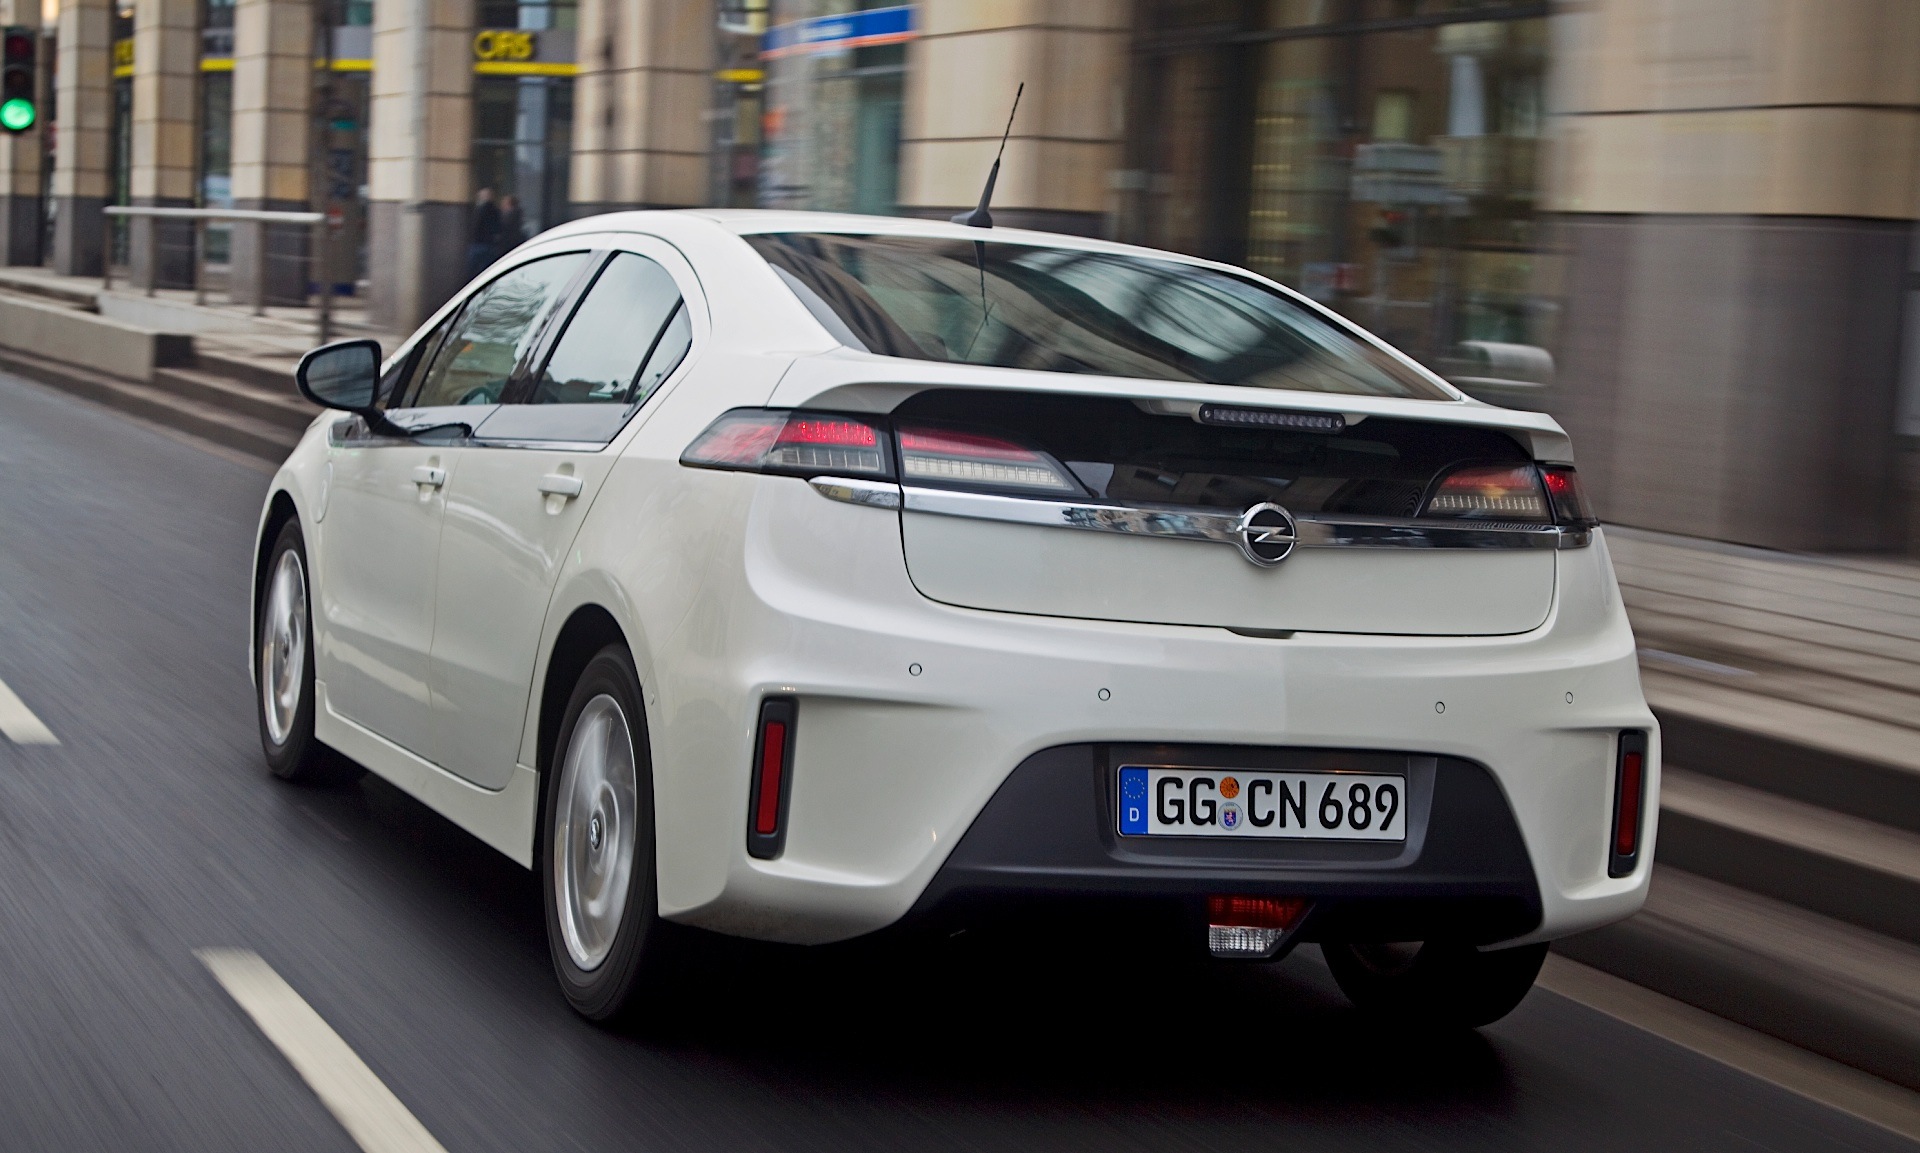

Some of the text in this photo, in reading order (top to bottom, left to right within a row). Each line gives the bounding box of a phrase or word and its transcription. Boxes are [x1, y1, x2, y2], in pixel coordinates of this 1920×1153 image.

[1129, 807, 1140, 822] D
[1156, 776, 1399, 831] GG CN 689
